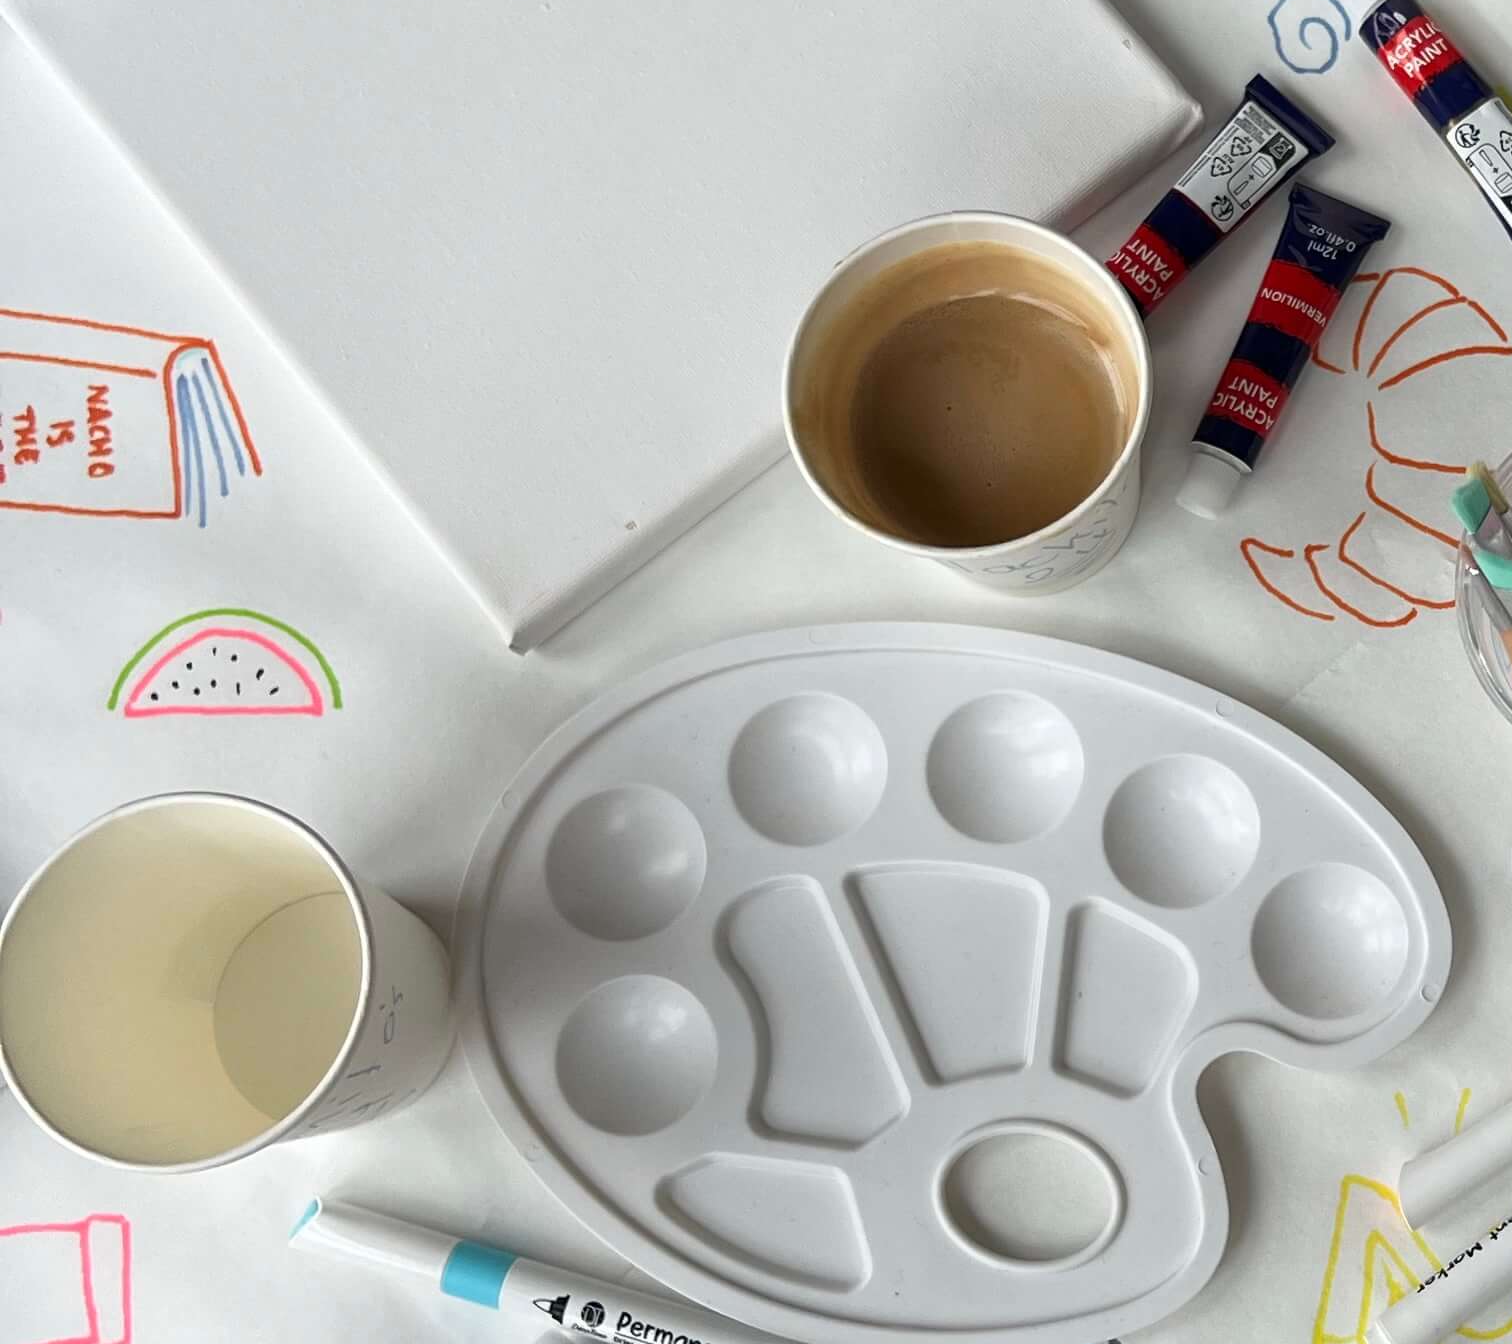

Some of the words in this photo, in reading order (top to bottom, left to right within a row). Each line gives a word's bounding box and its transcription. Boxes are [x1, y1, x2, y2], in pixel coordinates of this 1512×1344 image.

[1401, 35, 1450, 79] PAINT
[1125, 235, 1176, 281] PAINT
[1306, 237, 1340, 262] 12ml
[1259, 282, 1330, 328] VERMILION
[1211, 388, 1276, 432] ACRYLIC
[1226, 372, 1279, 410] PAINT
[13, 404, 41, 465] THE
[46, 419, 75, 447] IS
[86, 384, 115, 479] NACHO
